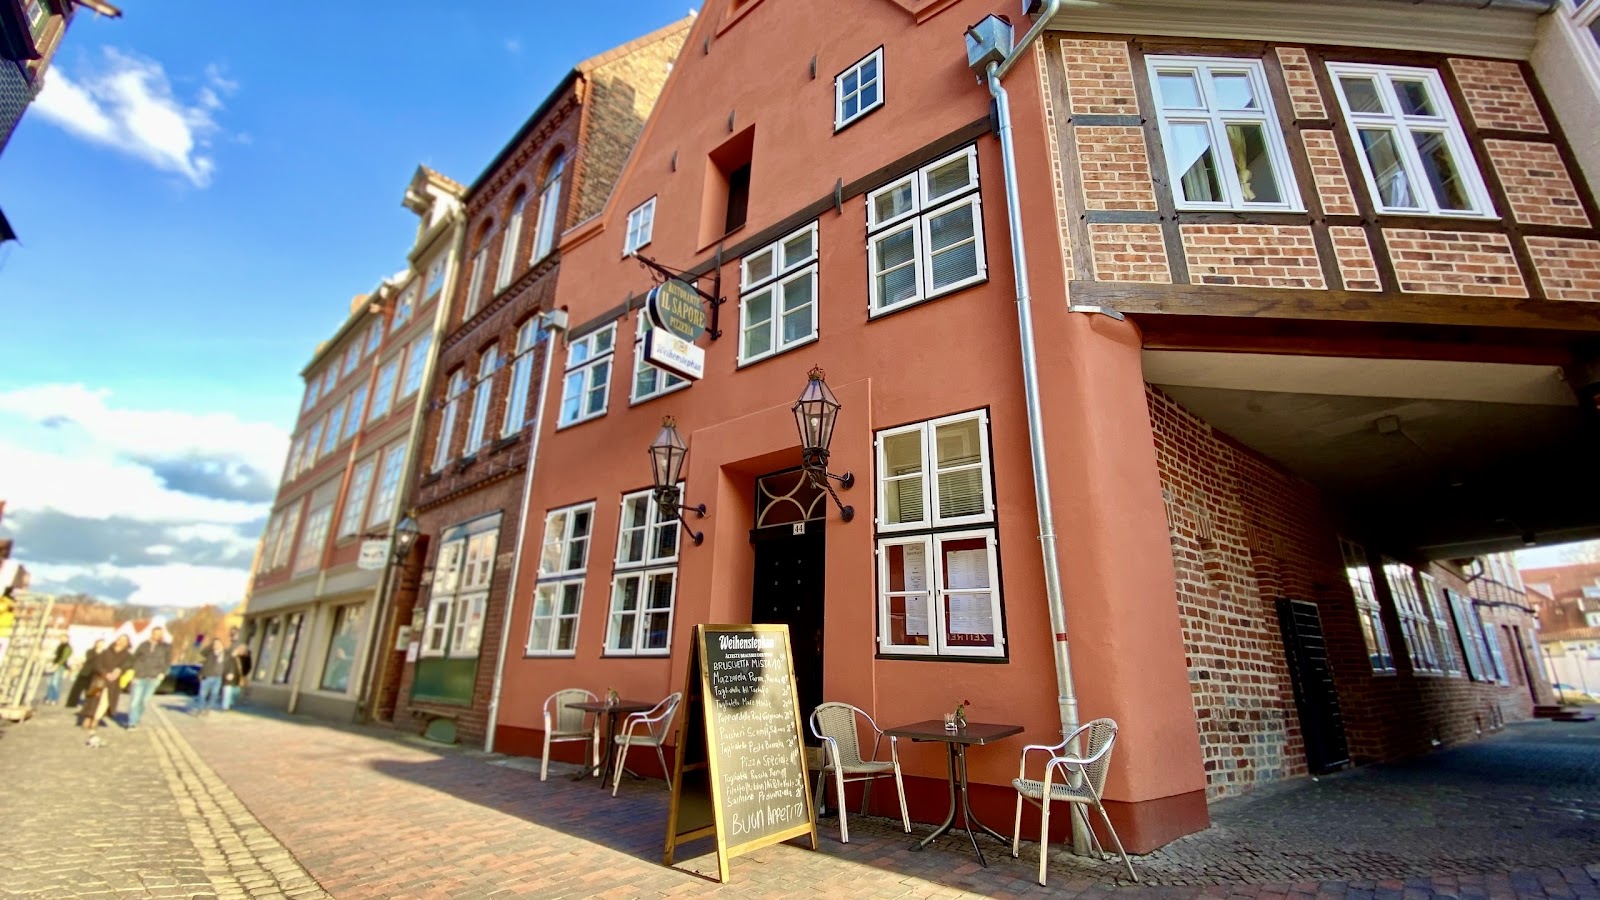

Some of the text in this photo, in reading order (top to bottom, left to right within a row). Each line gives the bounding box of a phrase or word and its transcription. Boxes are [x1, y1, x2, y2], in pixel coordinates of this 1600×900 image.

[668, 281, 701, 306] RISTORANTE
[661, 291, 705, 329] IL SAPORE
[670, 316, 693, 337] PIZZERIA
[795, 525, 803, 533] 44
[719, 635, 775, 651] Weihenstephan
[768, 802, 803, 825] APPETITO
